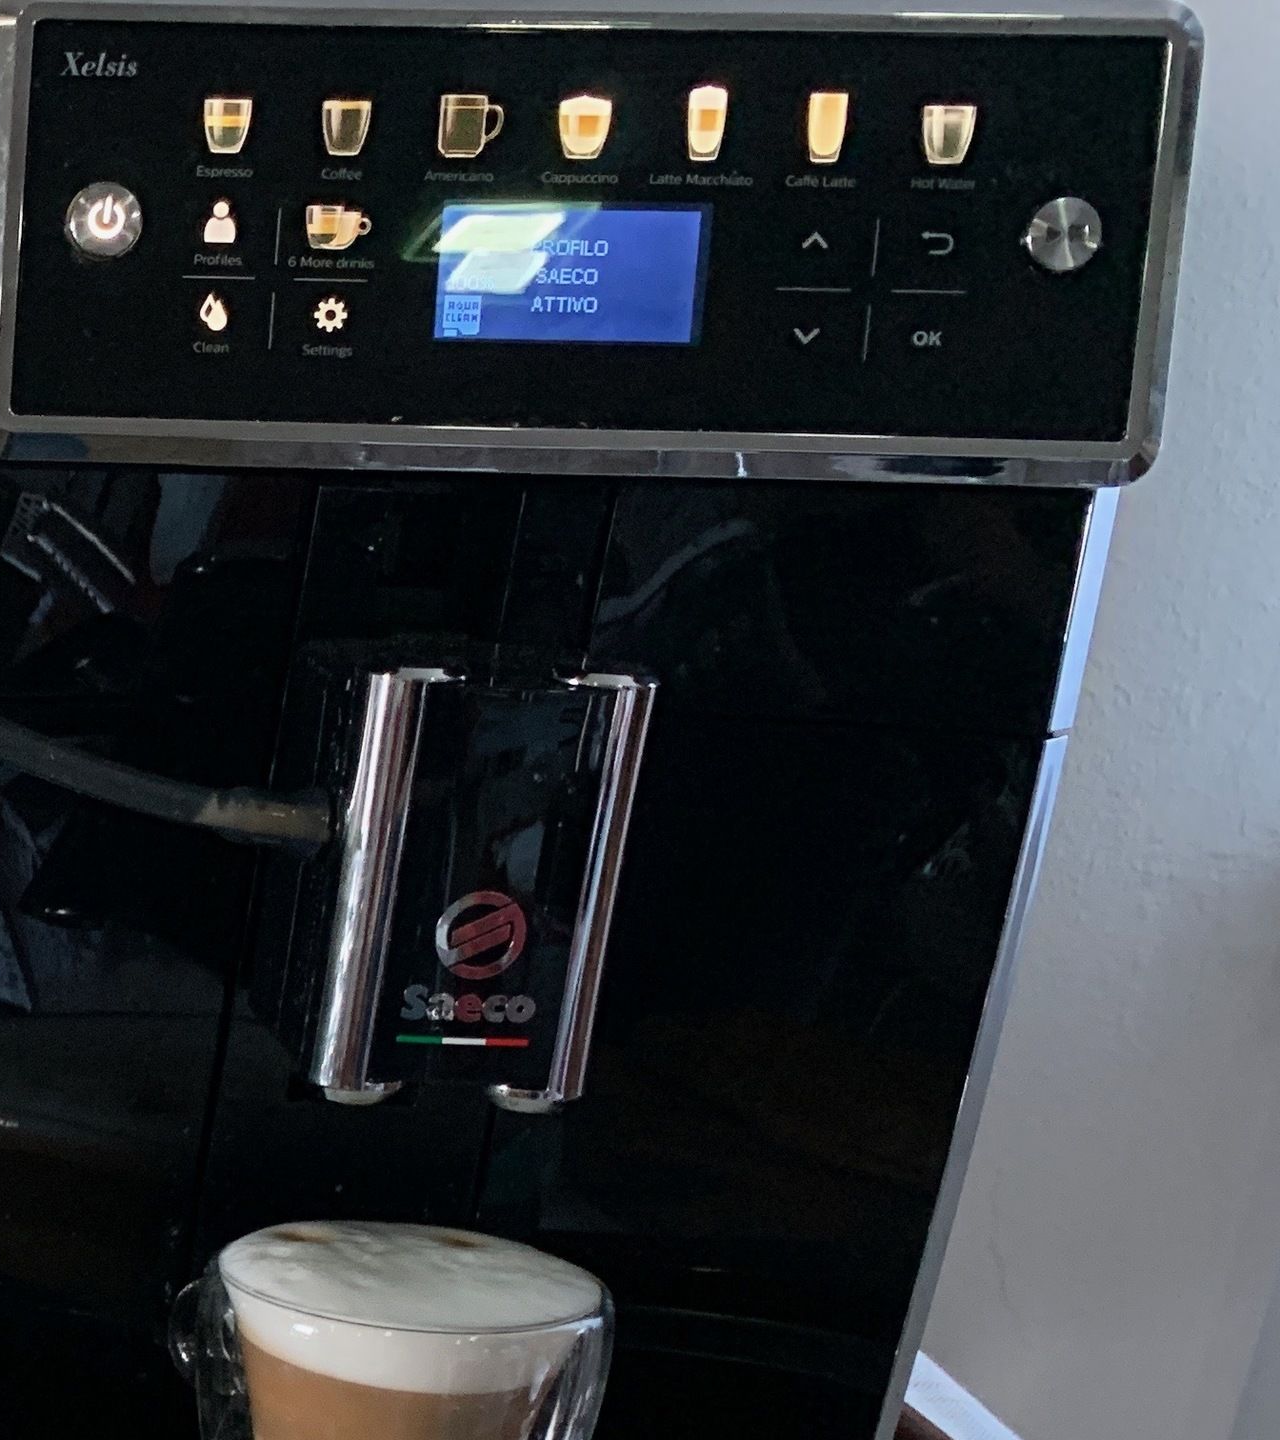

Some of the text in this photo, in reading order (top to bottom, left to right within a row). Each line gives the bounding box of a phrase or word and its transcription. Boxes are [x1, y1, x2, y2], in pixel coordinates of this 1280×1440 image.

[59, 51, 139, 78] Xelsis
[195, 164, 254, 179] Espresso
[320, 167, 363, 181] Coffee
[424, 170, 494, 183] Americano
[540, 172, 619, 187] Cappuccino
[648, 173, 754, 188] Latte Macchiato
[822, 175, 857, 189] Latte
[910, 177, 936, 191] Hot
[192, 253, 243, 267] Profiles
[287, 256, 376, 269] 6 More drinks
[535, 267, 599, 286] SAECO
[530, 296, 599, 313] ATTIVO
[912, 330, 943, 347] OK
[192, 341, 230, 354] Clean
[301, 343, 353, 359] Settings
[399, 983, 537, 1024] Saeco
